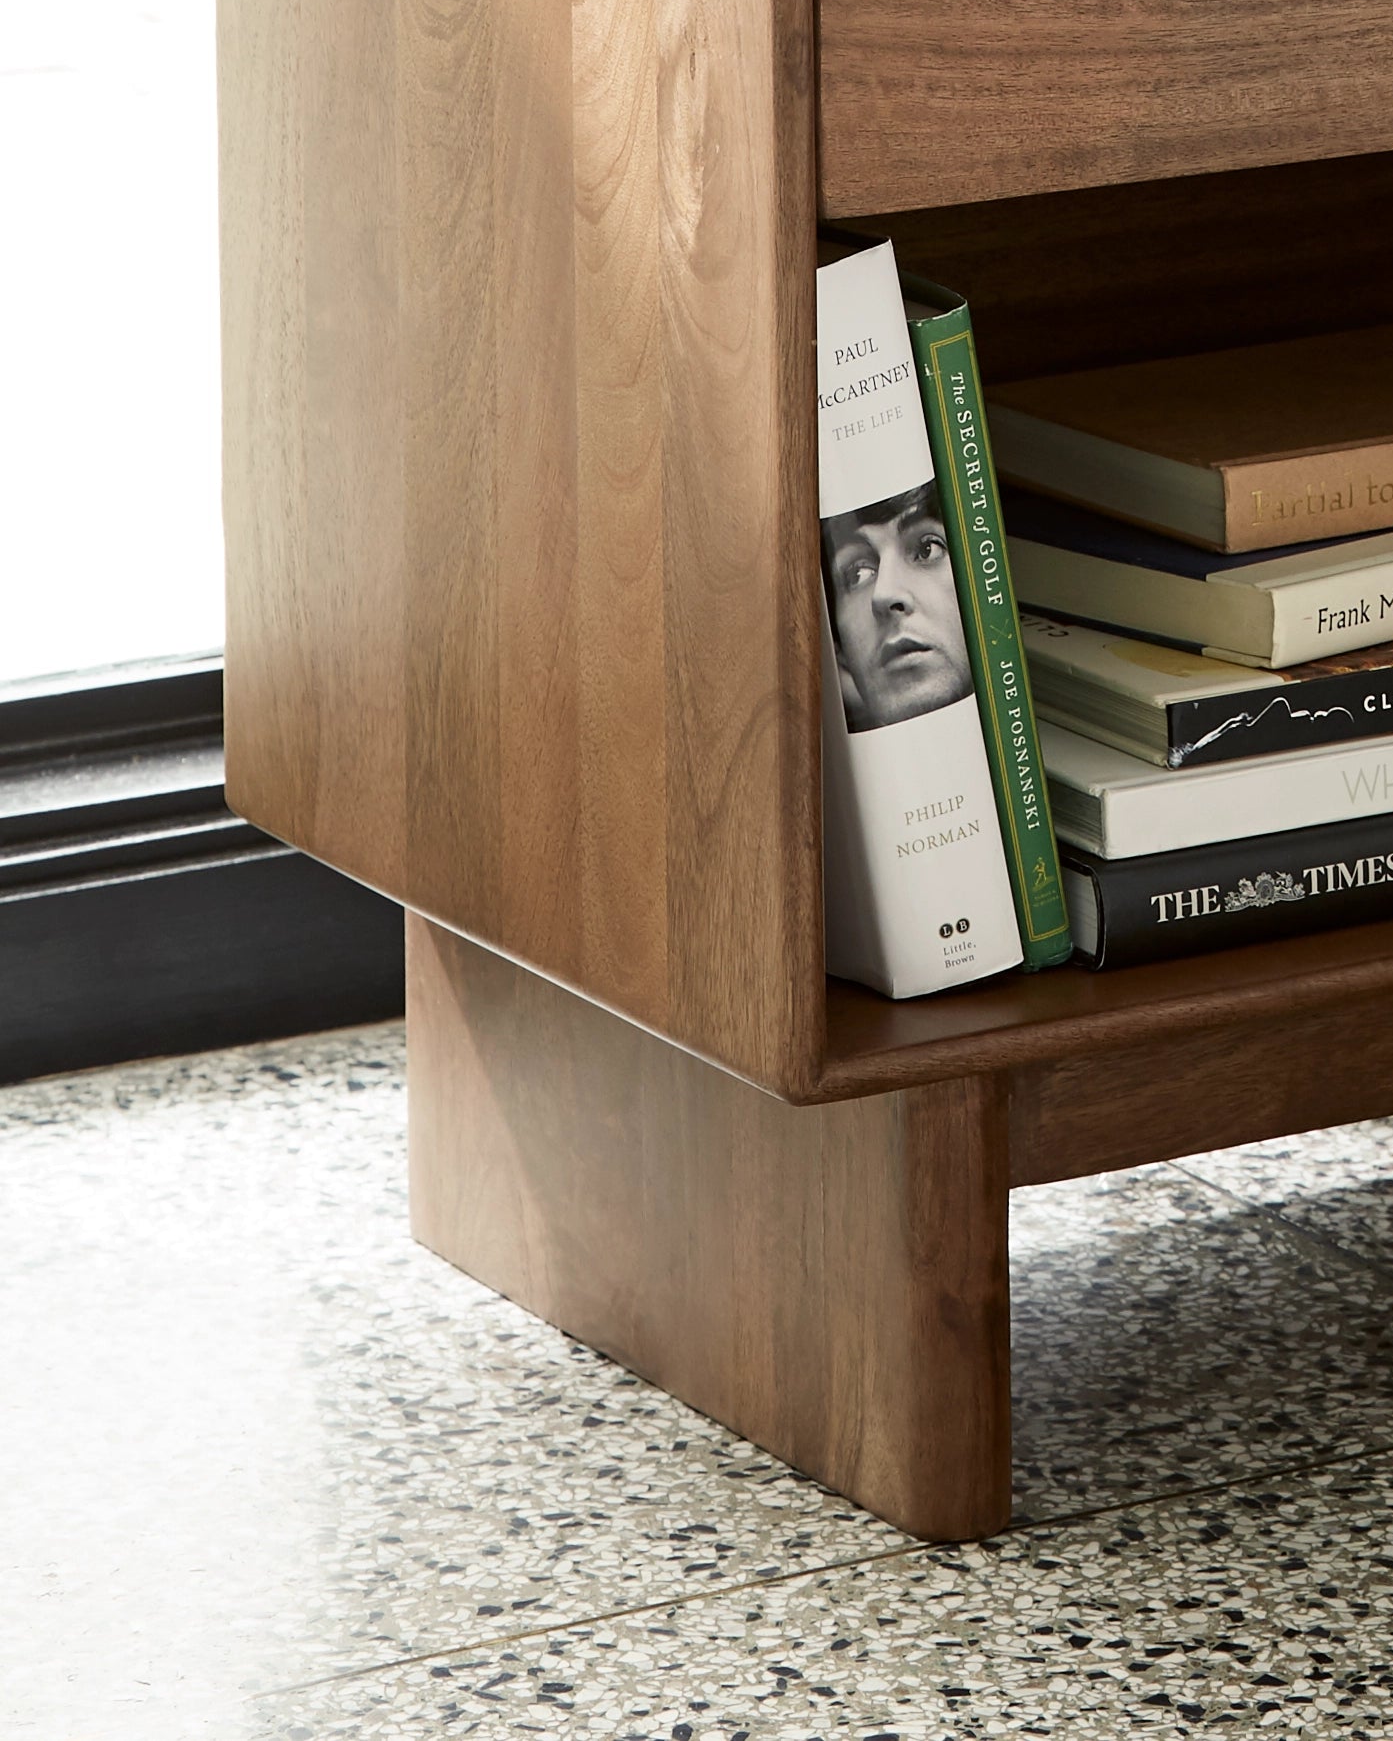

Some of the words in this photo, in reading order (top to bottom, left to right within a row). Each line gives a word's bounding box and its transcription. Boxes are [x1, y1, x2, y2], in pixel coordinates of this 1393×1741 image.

[834, 337, 879, 366] PAUL
[950, 371, 966, 406] The
[832, 419, 867, 441] THE
[871, 405, 904, 429] LIFE
[957, 409, 988, 510] SECRET
[973, 515, 991, 534] of
[979, 538, 1004, 607] GOLF
[1317, 599, 1371, 634] Frank
[1000, 659, 1018, 701] JOE
[1008, 706, 1041, 831] POSNANSKI
[903, 794, 966, 826] PHILIP
[896, 819, 981, 859] NORMAN
[1150, 885, 1222, 924] THE
[944, 954, 975, 969] Brown
